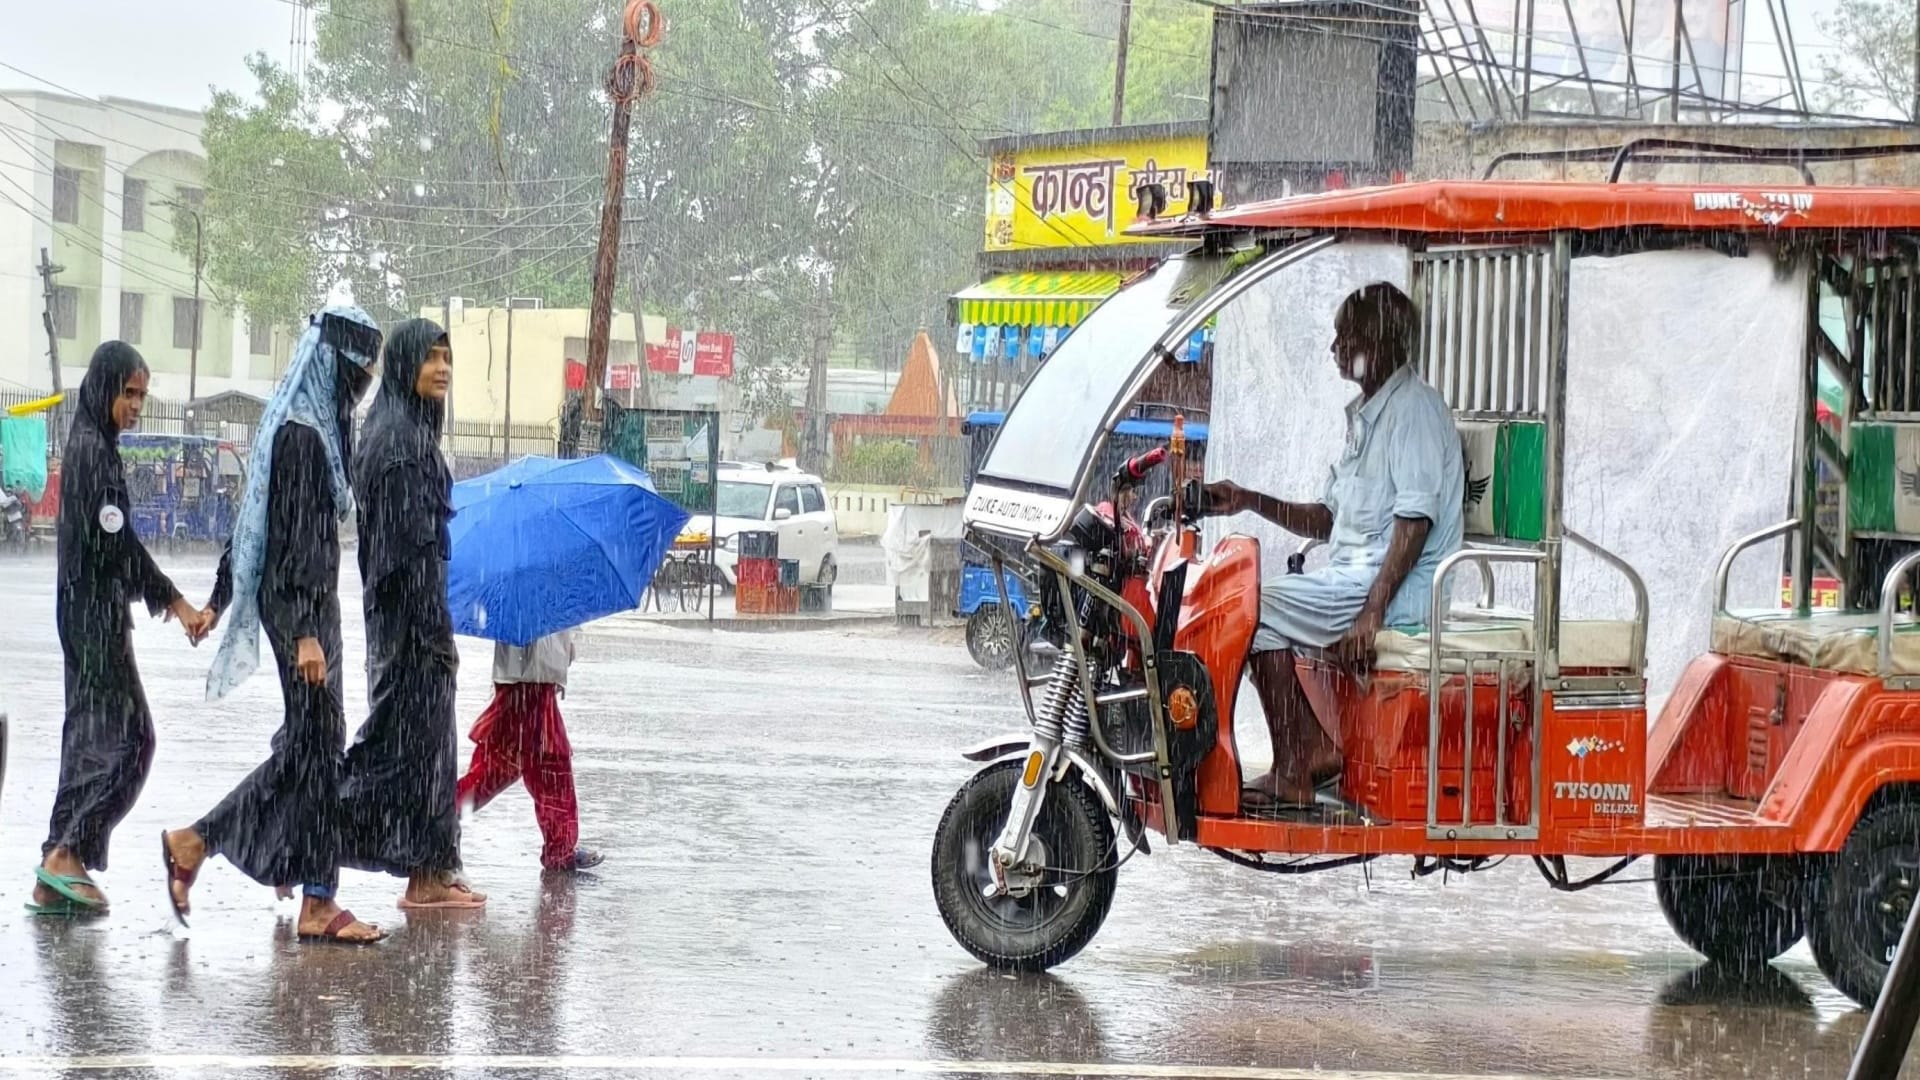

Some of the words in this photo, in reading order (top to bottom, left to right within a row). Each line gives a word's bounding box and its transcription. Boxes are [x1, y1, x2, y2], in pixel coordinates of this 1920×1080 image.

[1024, 159, 1125, 230] कान्हा
[1693, 192, 1742, 210] DUKE
[972, 496, 998, 514] DUKE
[997, 501, 1020, 518] AUTO
[1019, 504, 1044, 522] INDIA
[1553, 782, 1631, 800] TYSONN
[1594, 803, 1638, 814] DELUXE
